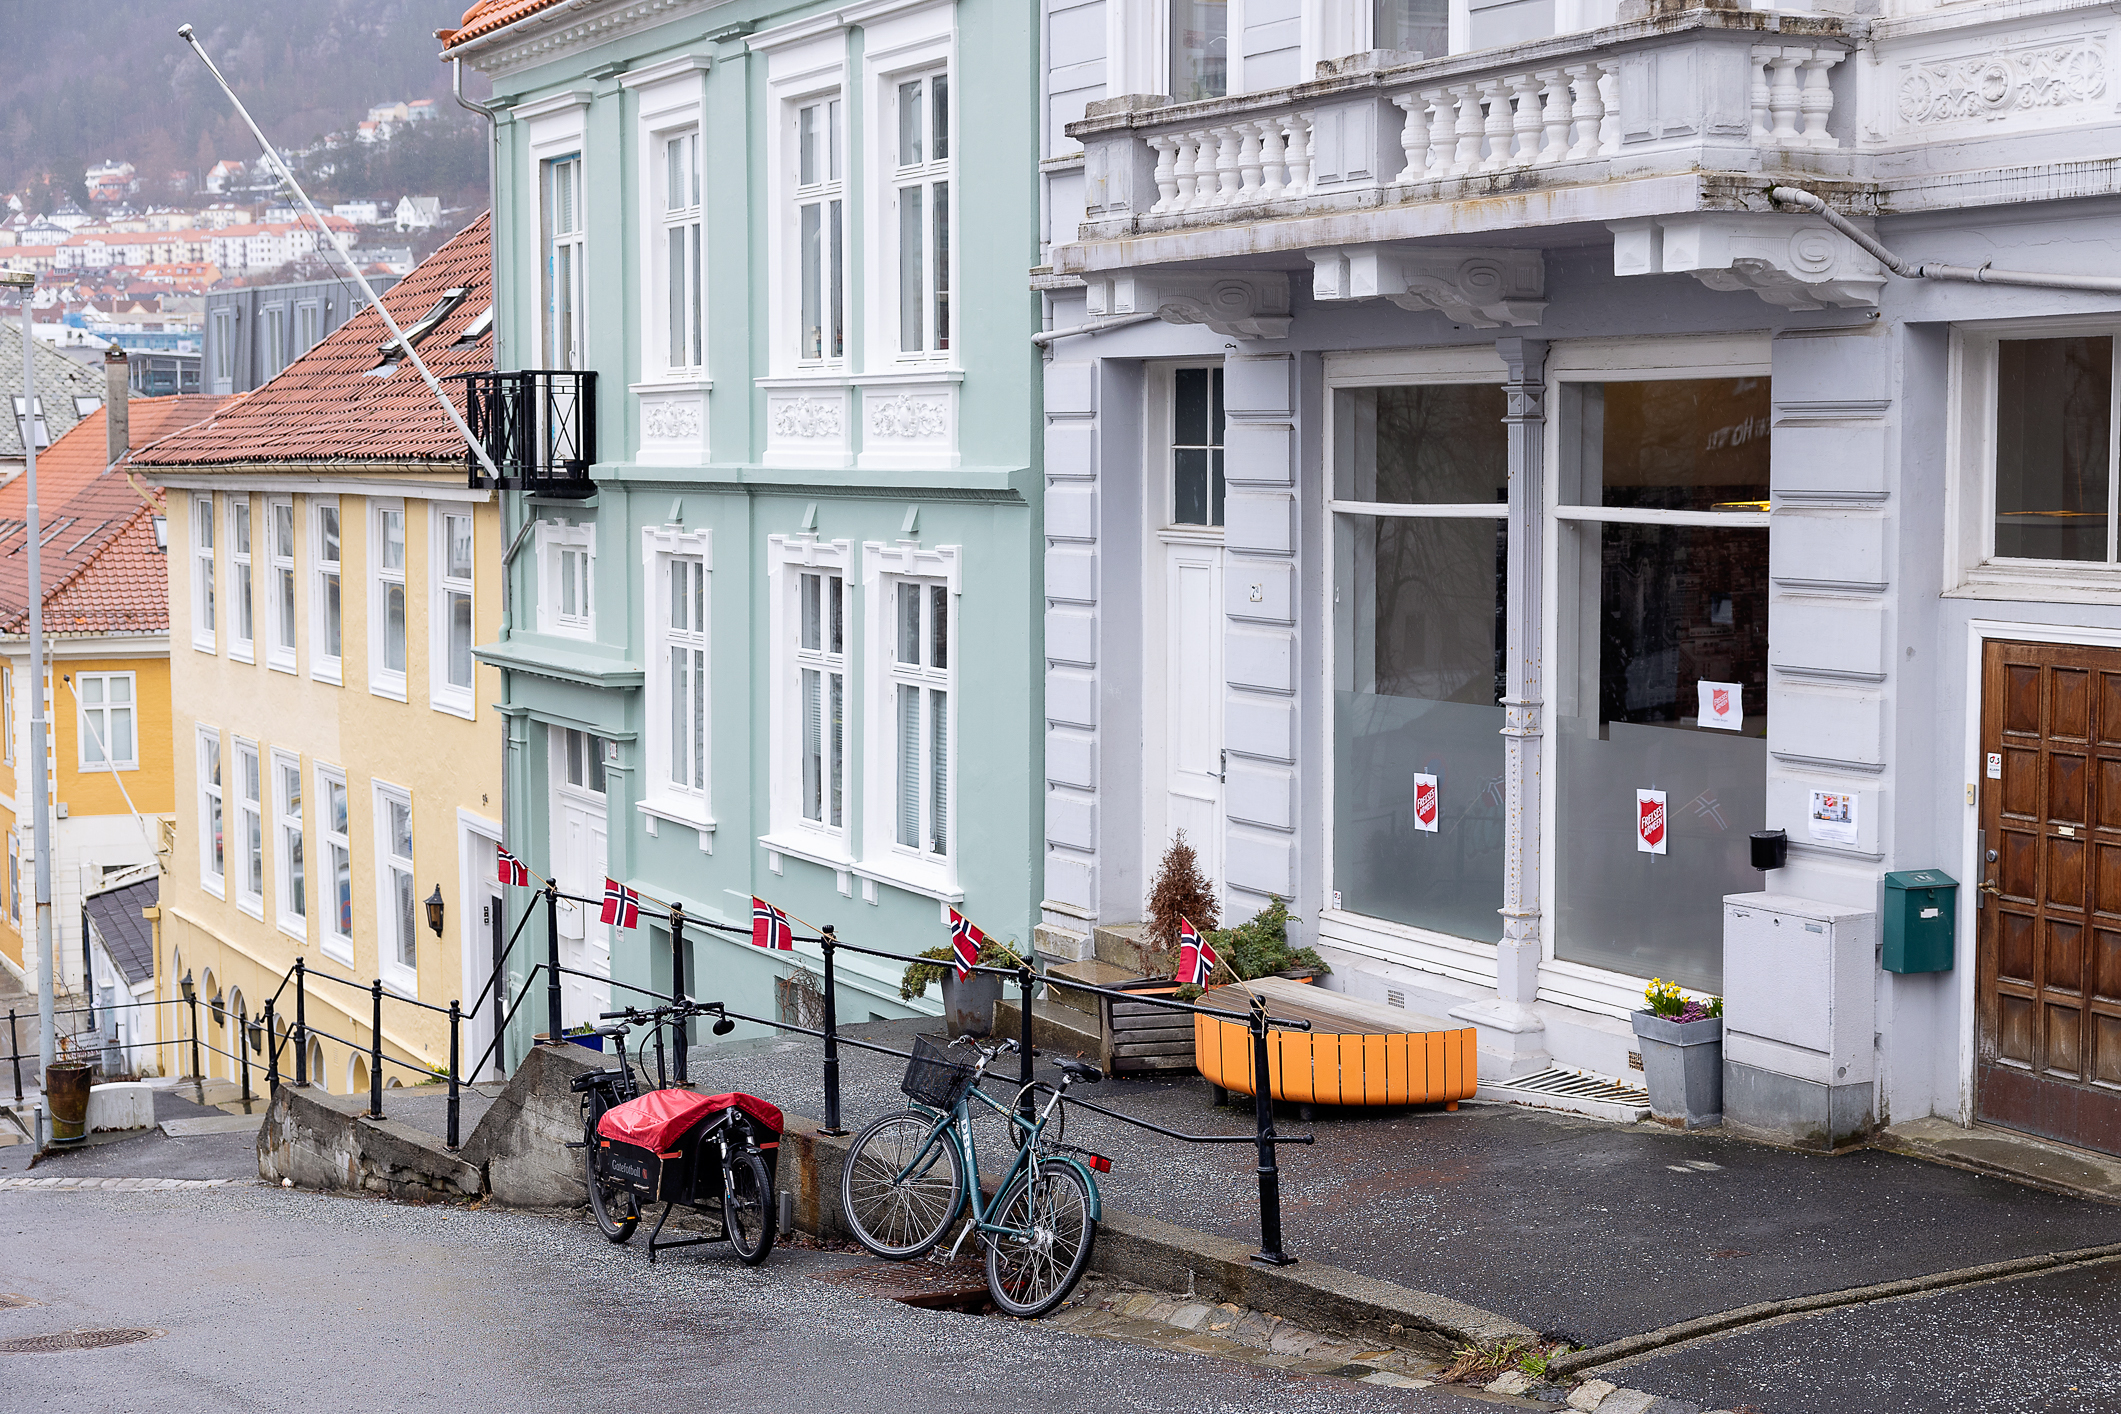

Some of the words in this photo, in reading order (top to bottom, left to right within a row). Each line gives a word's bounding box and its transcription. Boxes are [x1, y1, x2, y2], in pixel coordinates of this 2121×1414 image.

[1641, 805, 1663, 830] FRELSES
[1643, 816, 1663, 838] ARMEEN
[960, 1118, 973, 1162] DBS
[611, 1159, 641, 1178] Gatefotball
